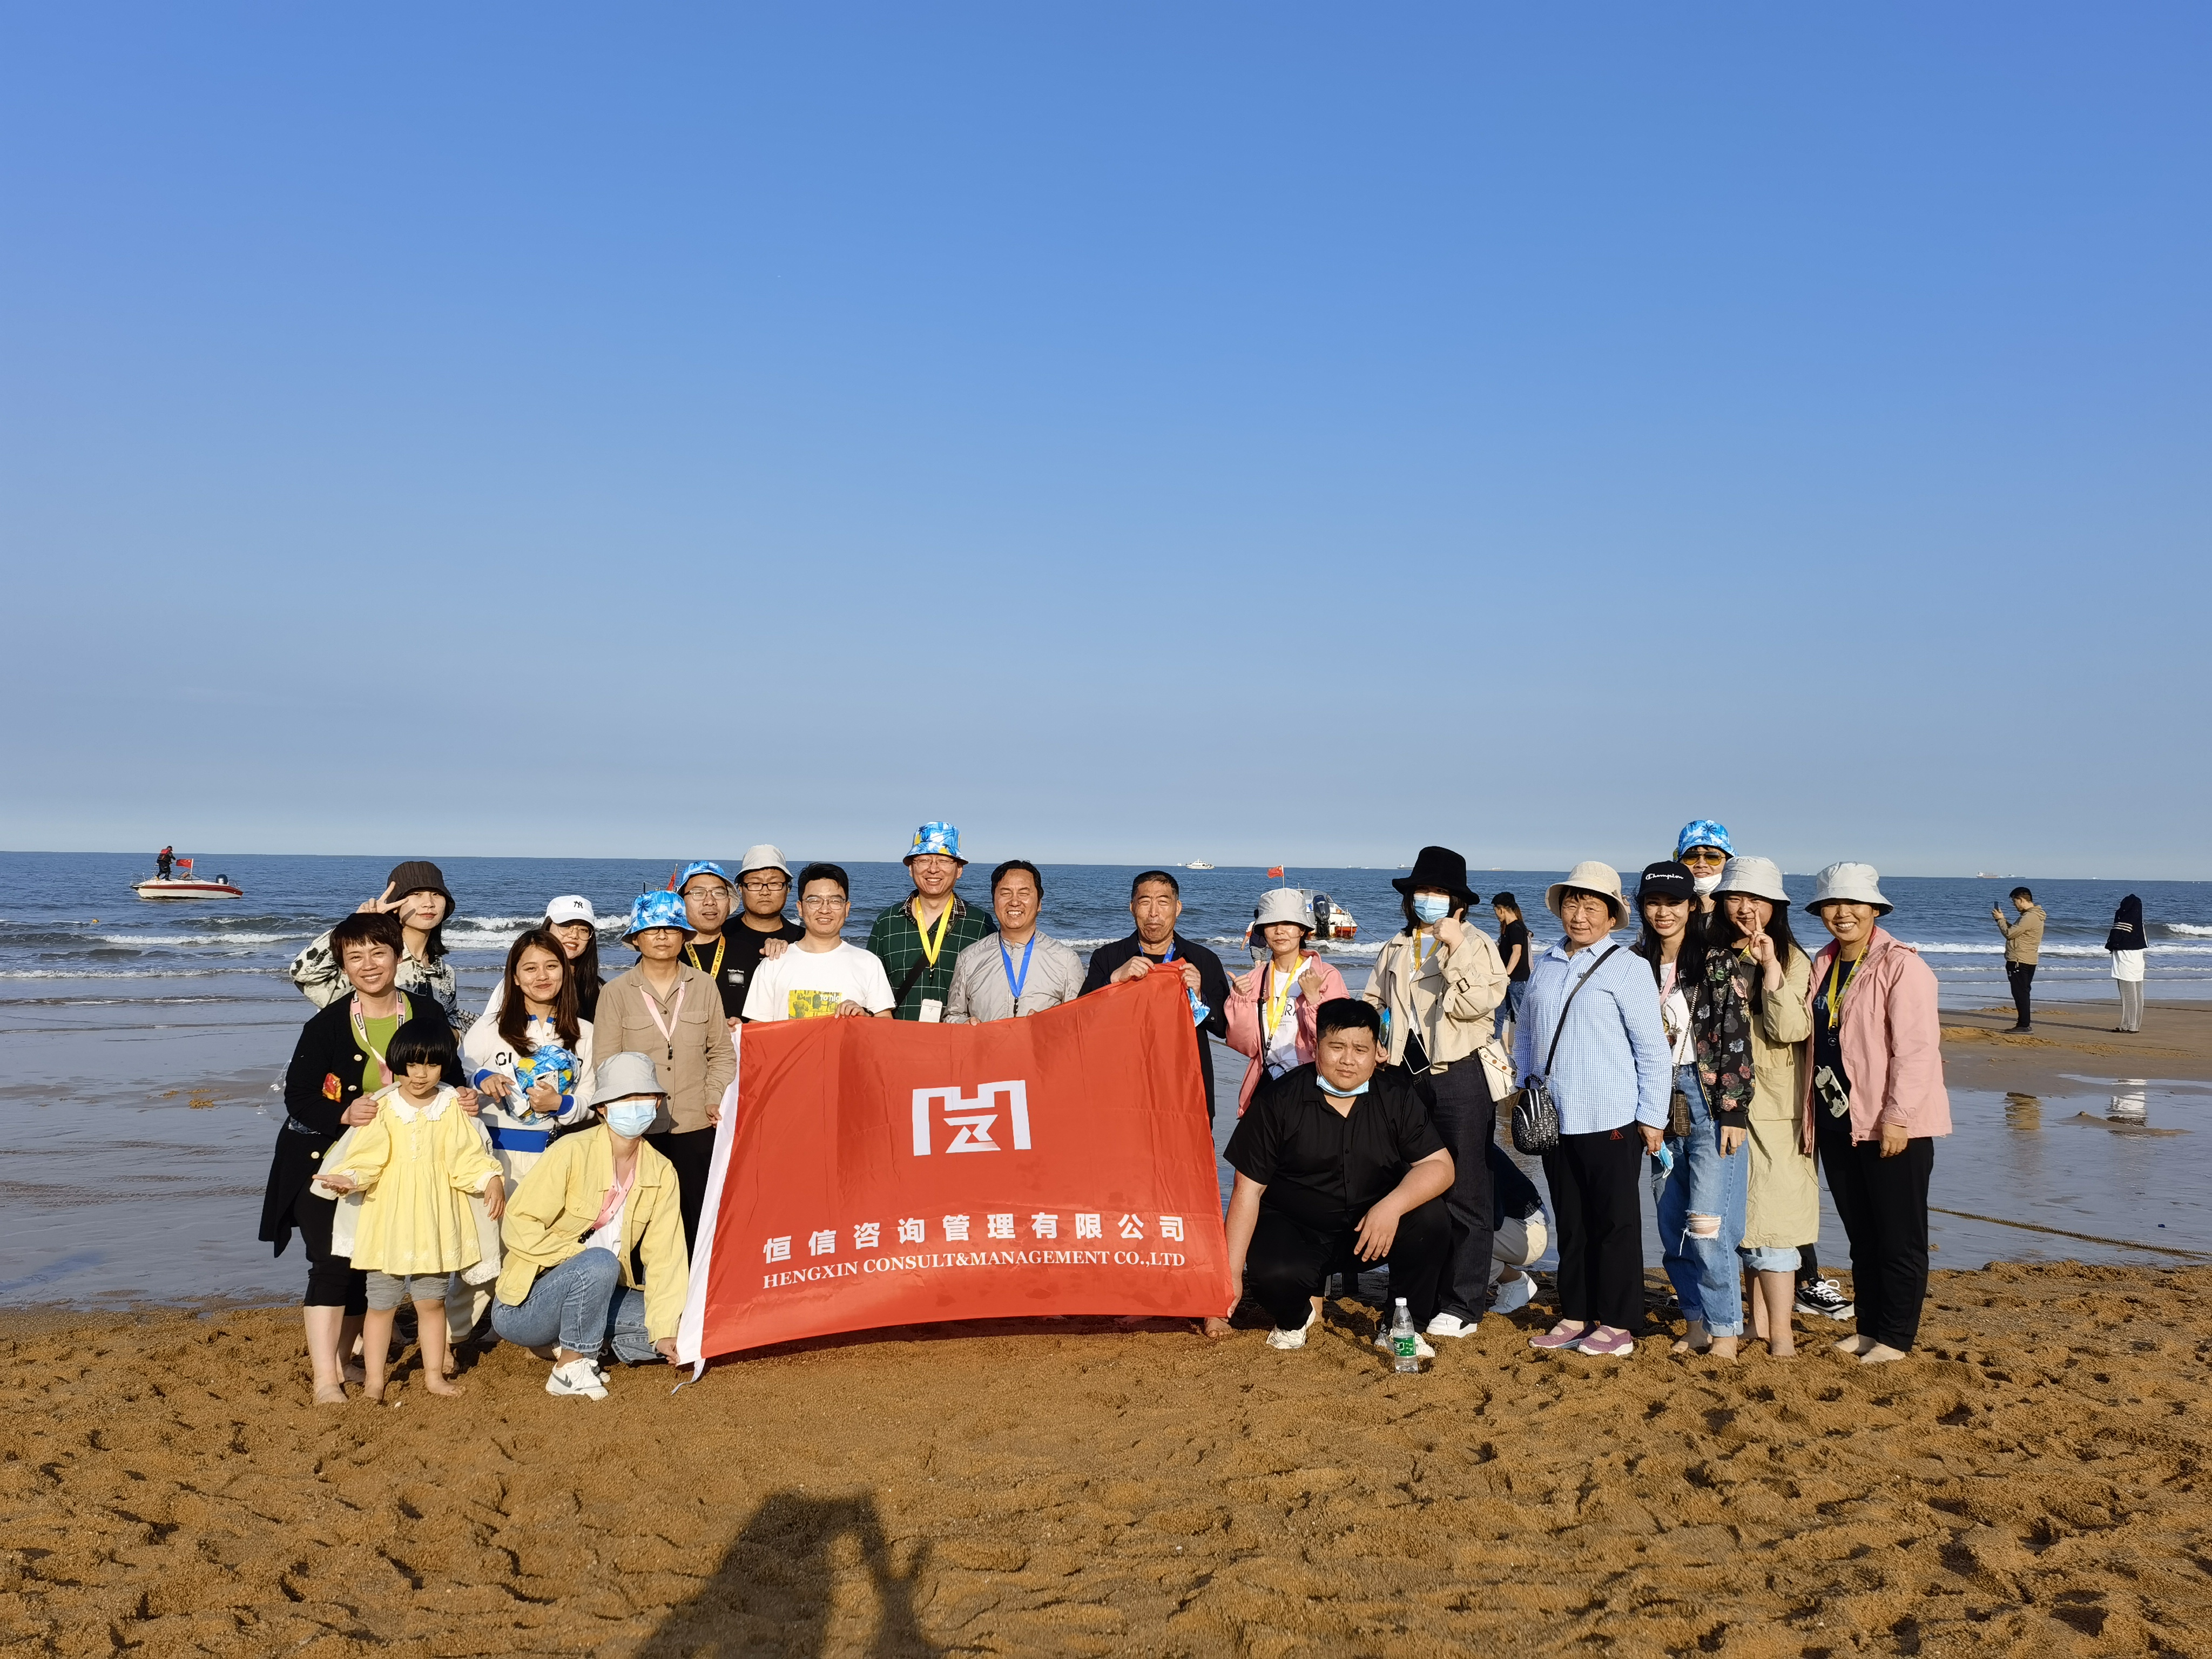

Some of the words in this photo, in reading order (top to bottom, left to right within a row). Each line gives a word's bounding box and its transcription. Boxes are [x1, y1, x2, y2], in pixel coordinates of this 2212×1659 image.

[763, 1212, 1185, 1264] 恒信咨询管理有限公司
[762, 1260, 858, 1289] HENGXIN
[863, 1250, 1110, 1273] CONSULT&MANAGEMENT
[1114, 1250, 1185, 1268] CO.,LTD
